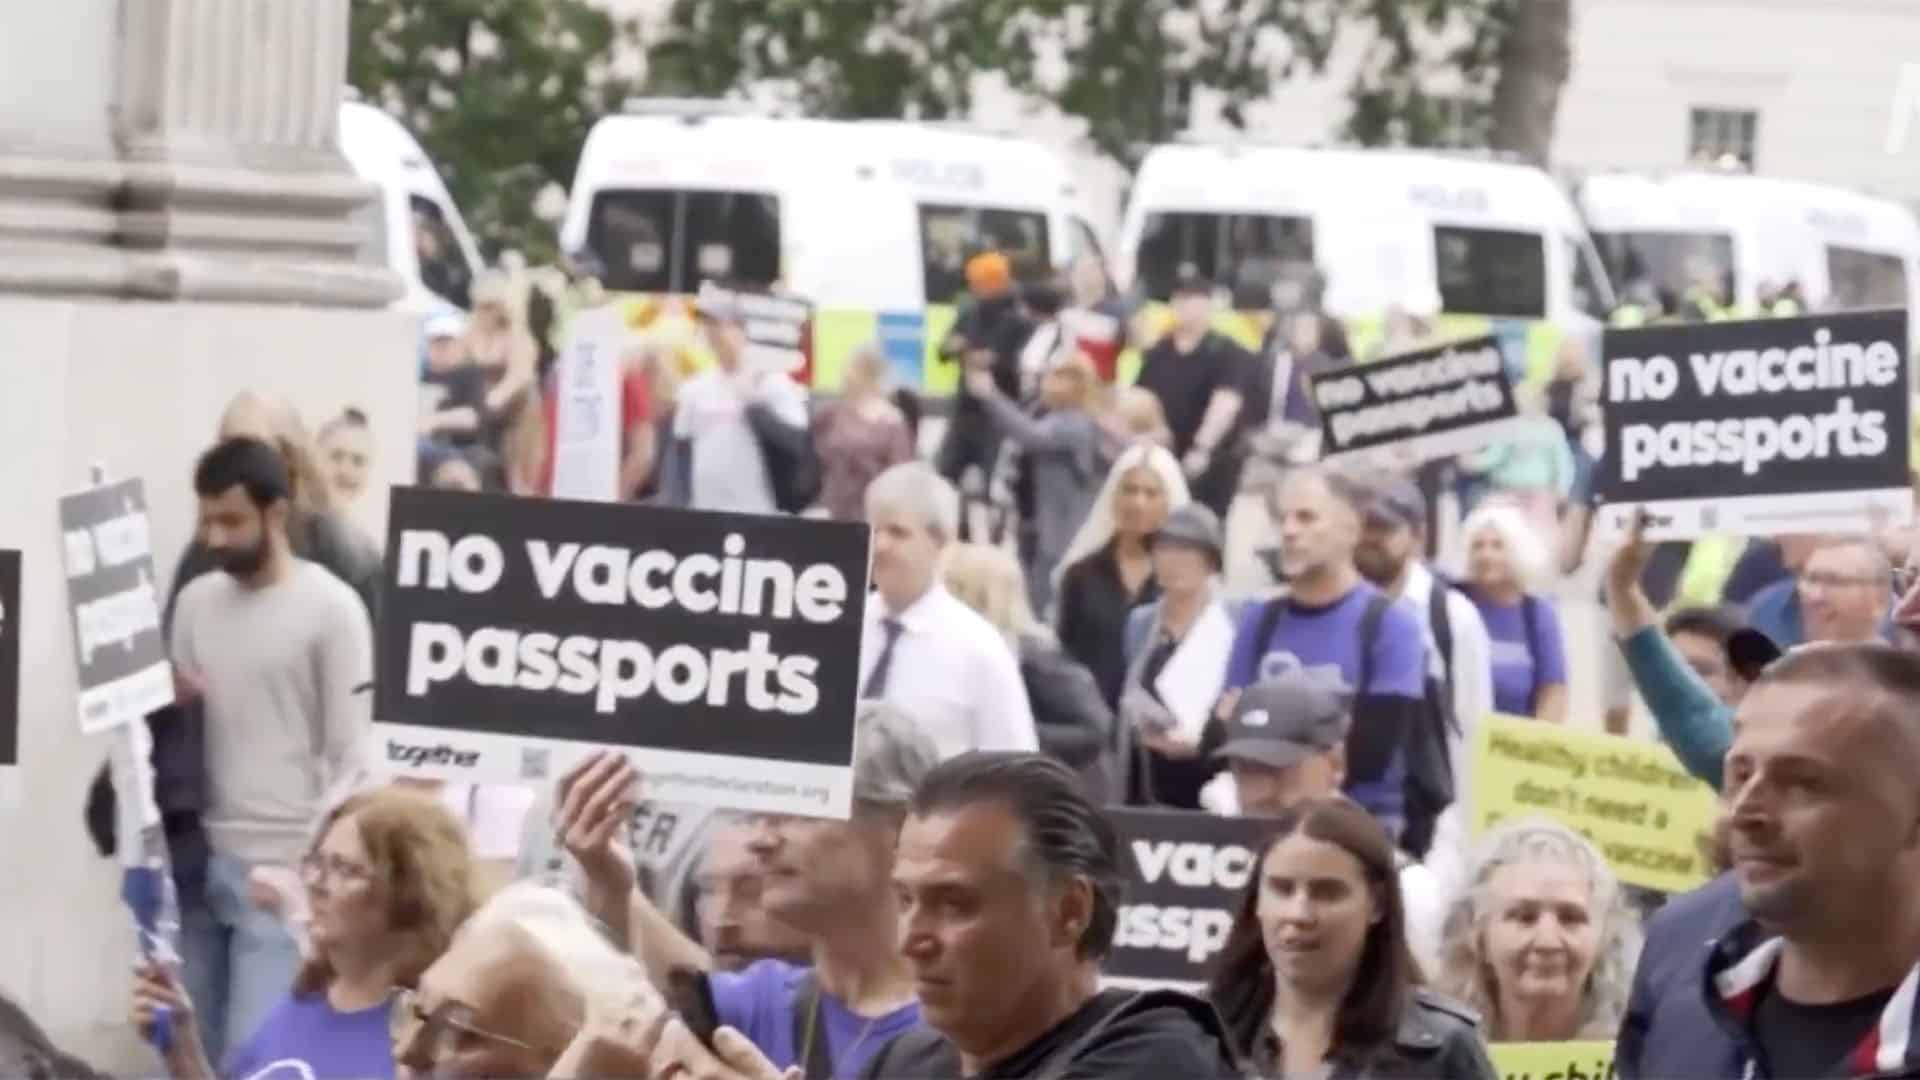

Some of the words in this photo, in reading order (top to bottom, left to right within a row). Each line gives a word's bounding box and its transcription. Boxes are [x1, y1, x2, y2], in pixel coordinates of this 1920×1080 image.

[1608, 355, 1679, 403] no
[1689, 327, 1899, 396] vaccine
[1620, 396, 1888, 482] passports
[397, 529, 503, 593] no
[524, 532, 848, 623] vaccine
[406, 621, 821, 714] passports
[386, 738, 481, 768] together
[1130, 839, 1258, 891] vac
